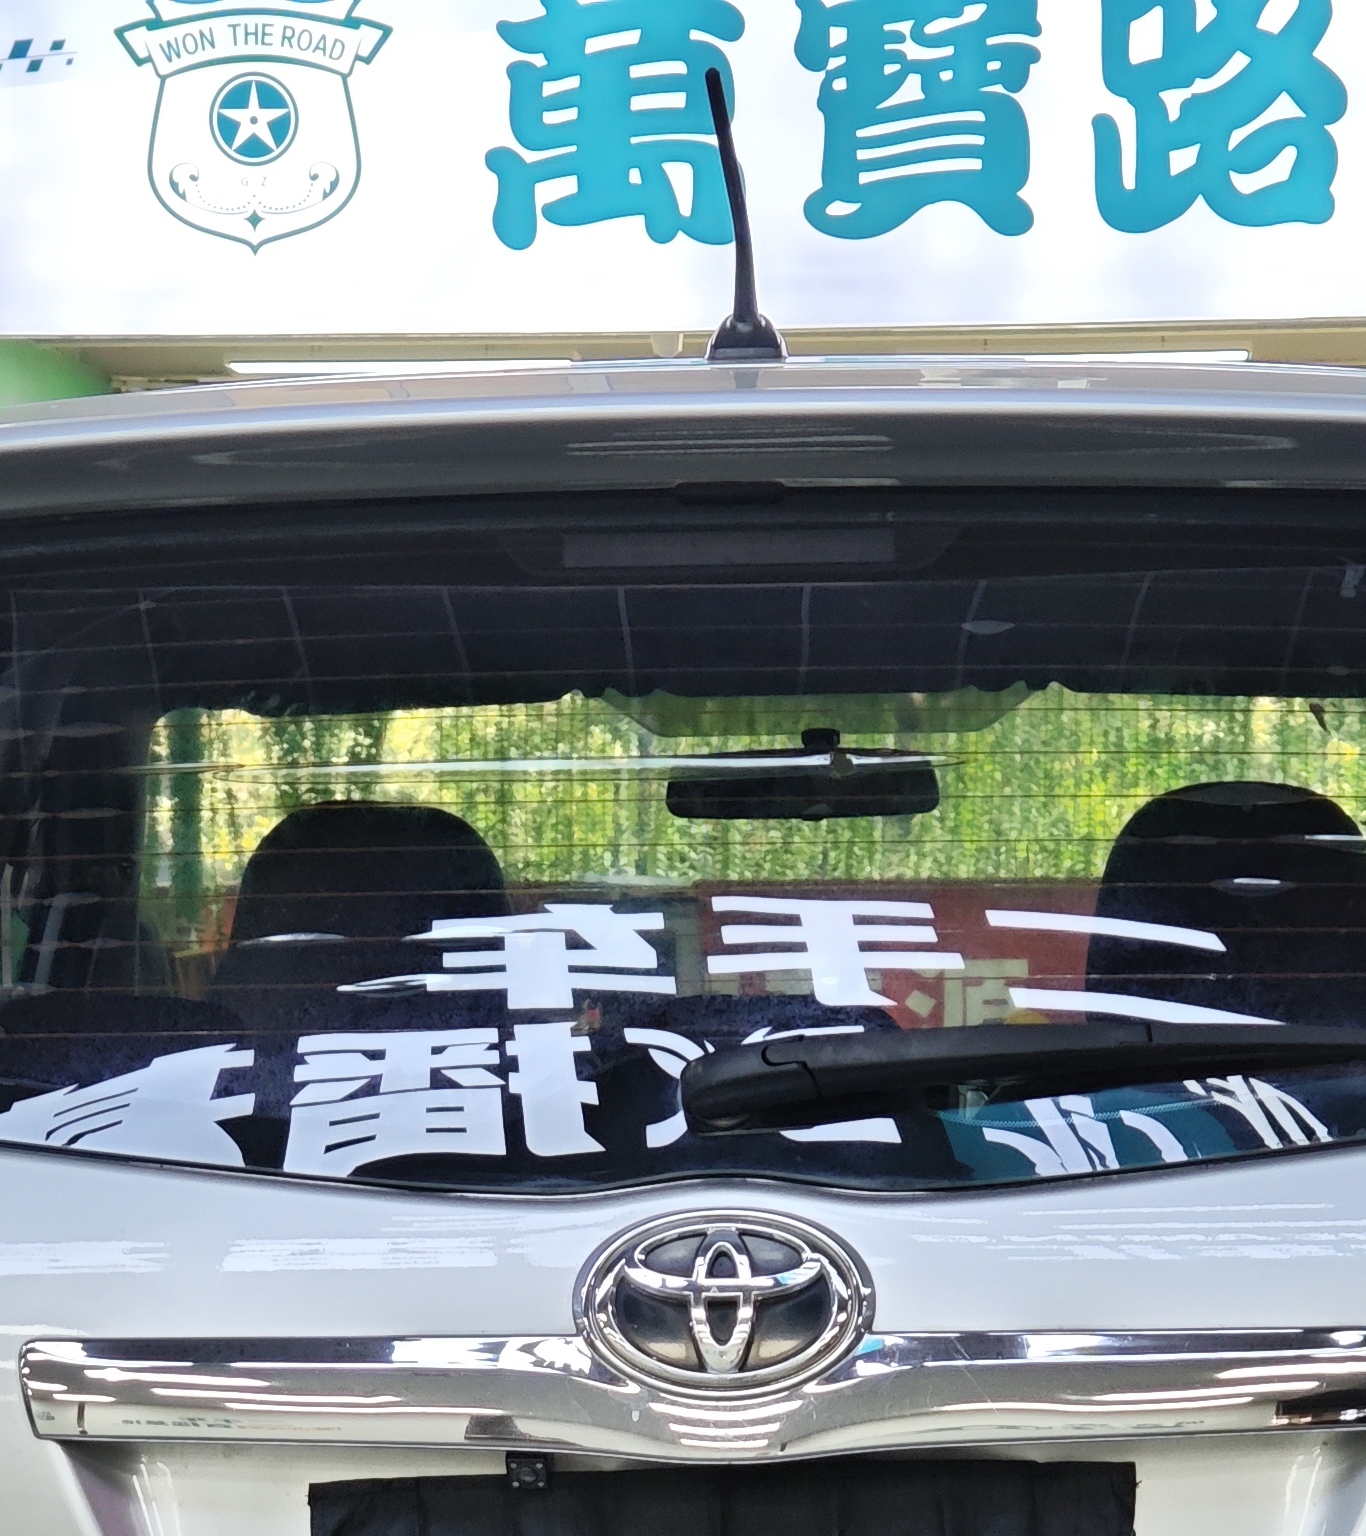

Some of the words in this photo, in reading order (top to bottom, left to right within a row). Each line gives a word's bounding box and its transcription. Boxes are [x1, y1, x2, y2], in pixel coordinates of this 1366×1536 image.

[159, 27, 216, 63] WON
[227, 23, 274, 46] THE
[281, 25, 346, 60] ROAD
